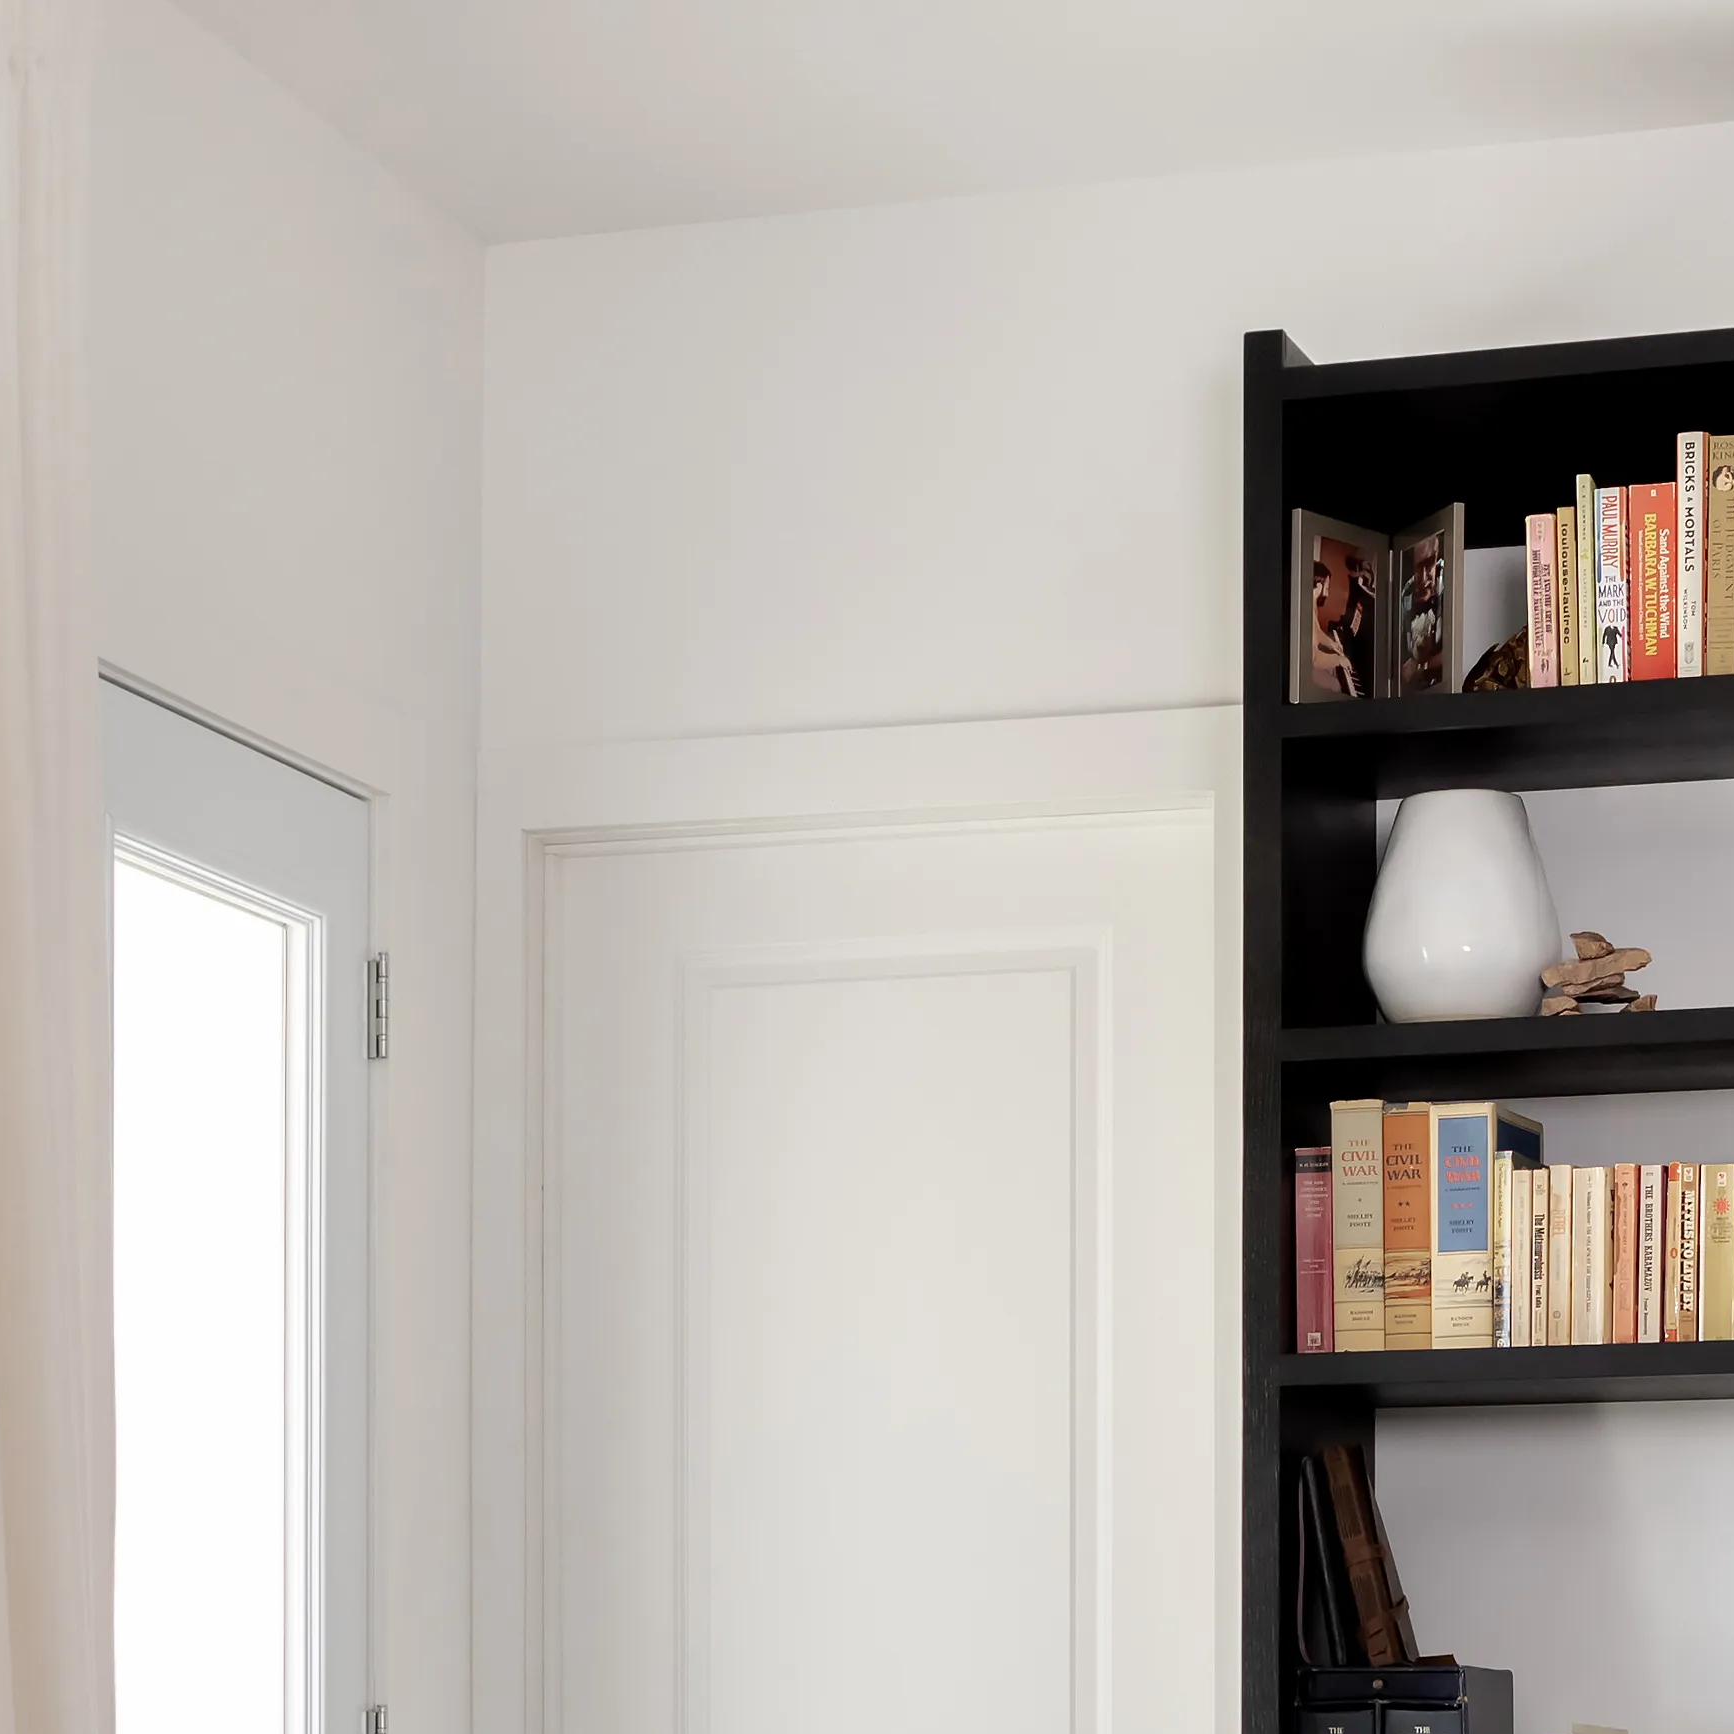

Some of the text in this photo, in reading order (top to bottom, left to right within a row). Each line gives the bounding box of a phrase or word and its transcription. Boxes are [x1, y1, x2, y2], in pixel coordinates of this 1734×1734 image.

[1685, 442, 1695, 492] BRICKS
[1601, 496, 1618, 568] PAUL MURRAY
[1685, 507, 1694, 572] MORTALS
[1561, 523, 1571, 644] toulouse-lautrec
[1598, 585, 1624, 597] MARK
[1598, 608, 1626, 622] VOID
[1645, 513, 1657, 656] BARBARA W. TUCHMAN
[1659, 529, 1670, 638] Sand Against the Wind
[1385, 1155, 1423, 1167] CIVIL
[1386, 1170, 1422, 1180] WAR
[1643, 1185, 1653, 1292] THE BROTHERS KARAMAZOV
[1680, 1190, 1694, 1312] MYTHS TO LIVE BY
